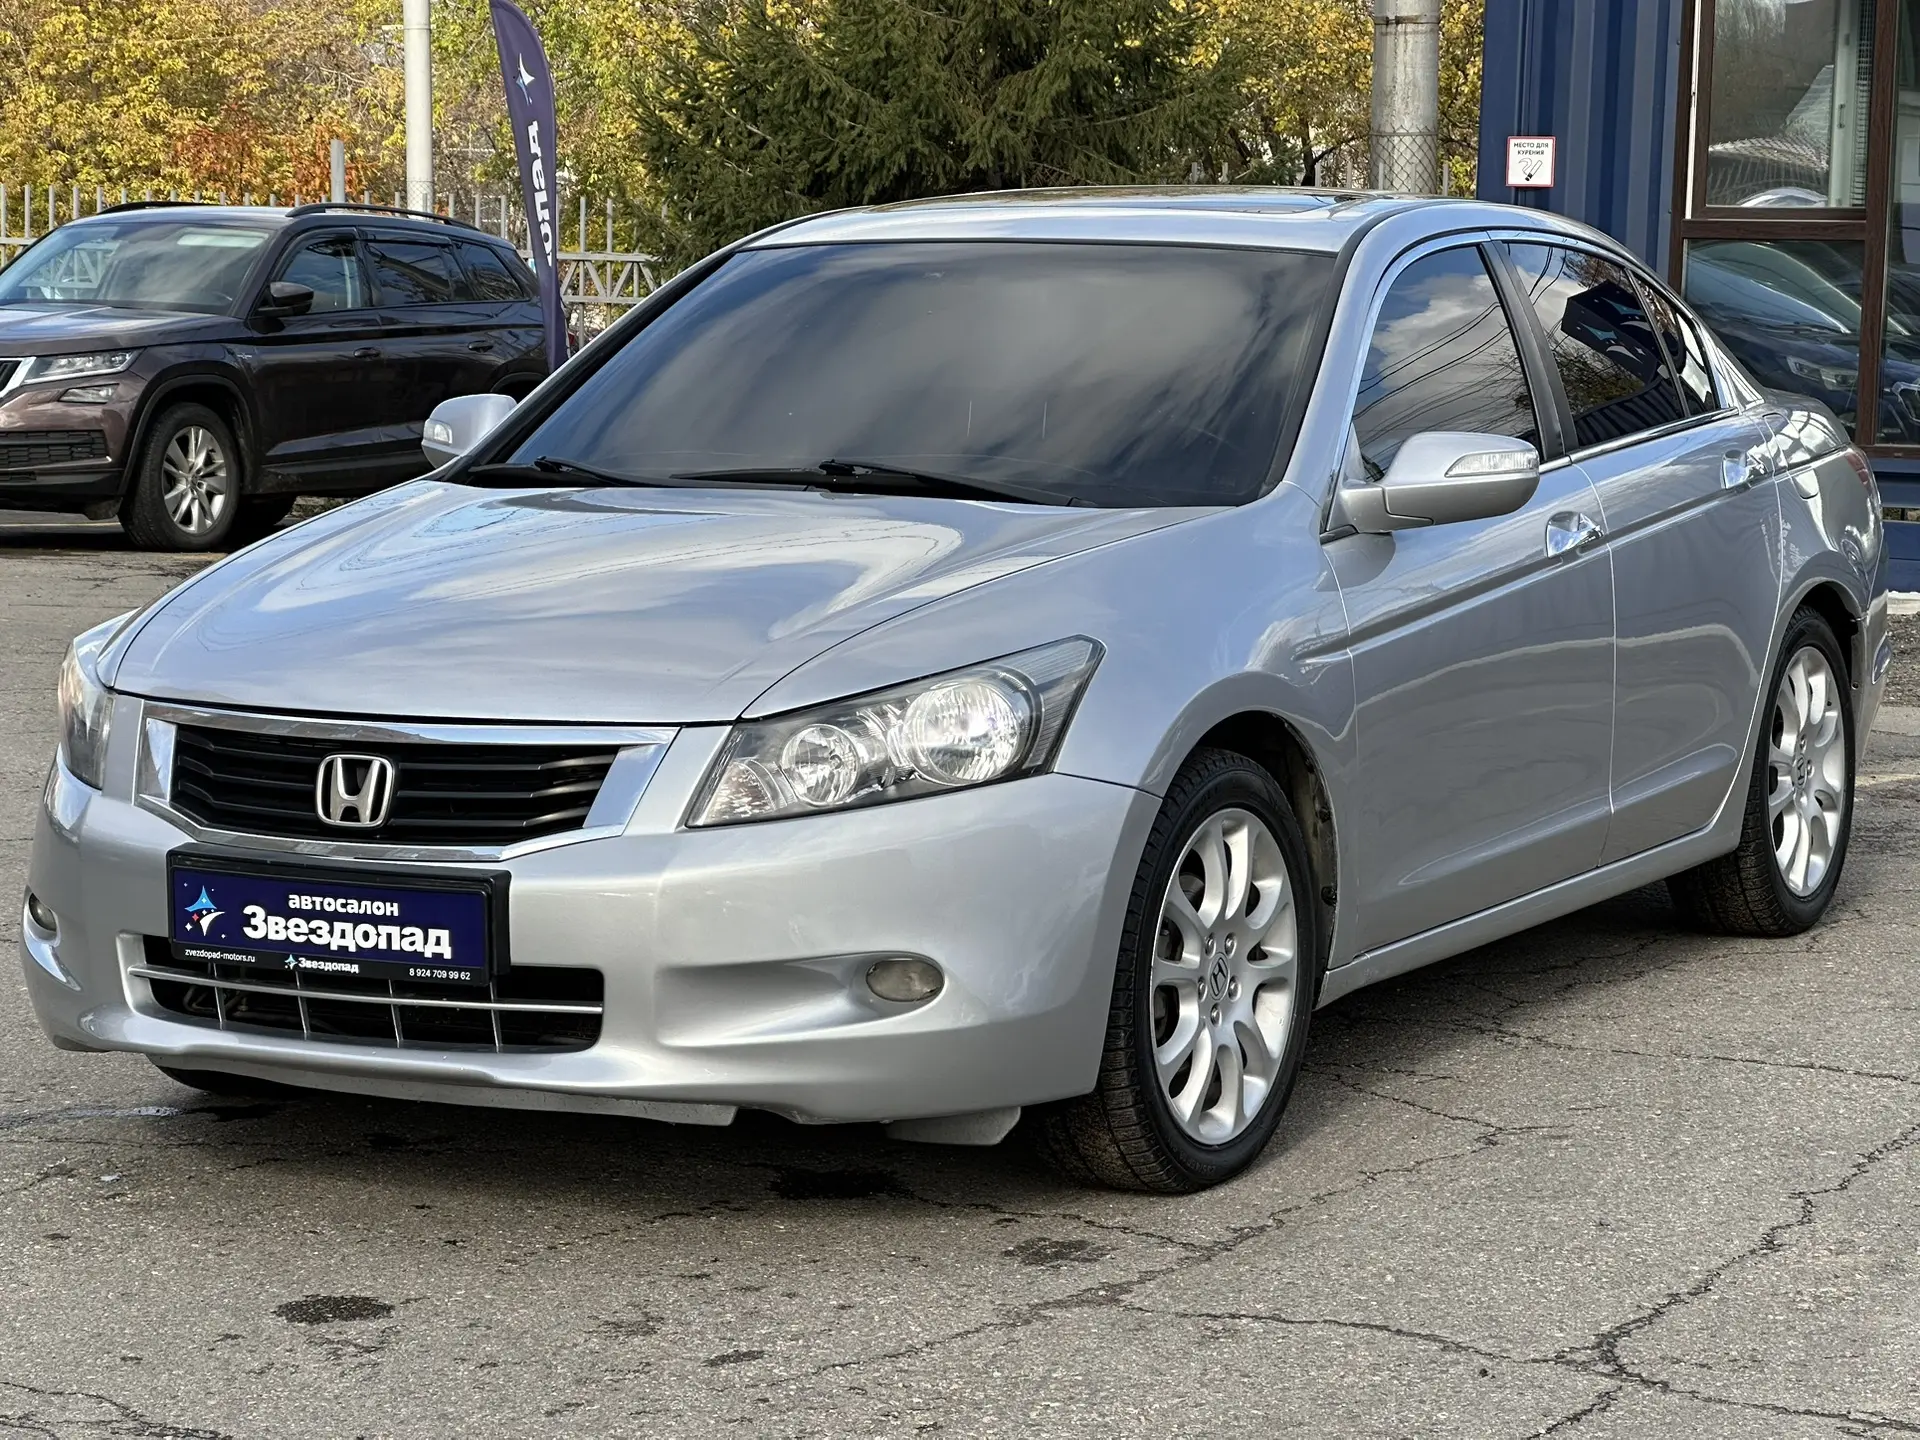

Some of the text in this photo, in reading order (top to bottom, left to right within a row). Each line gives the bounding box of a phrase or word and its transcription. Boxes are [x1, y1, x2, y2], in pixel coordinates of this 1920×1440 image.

[288, 893, 400, 917] автосалон
[242, 904, 453, 960] Звездопад
[184, 949, 256, 963] zvezdopad-motors.ru
[298, 957, 360, 974] Звездопад
